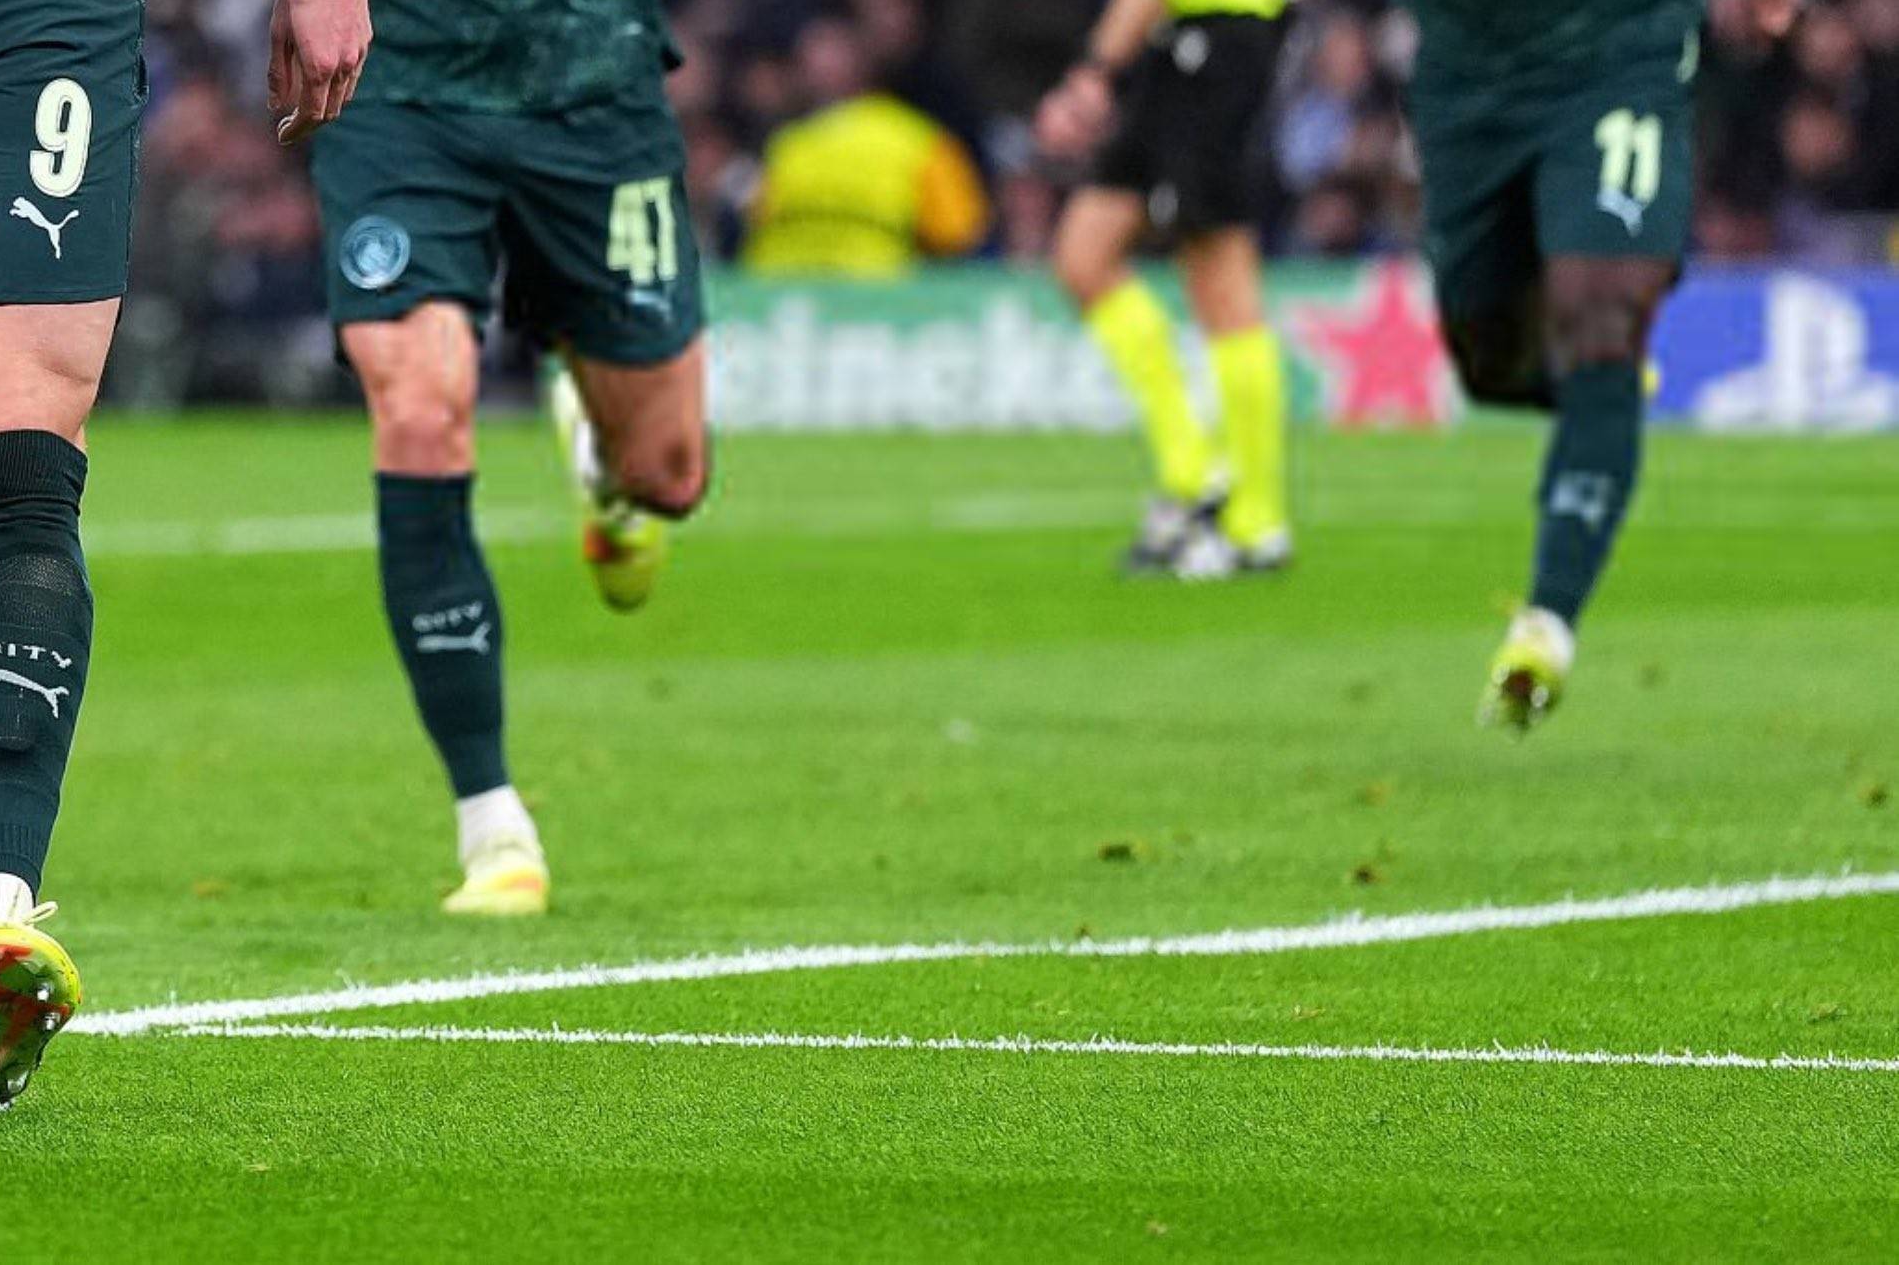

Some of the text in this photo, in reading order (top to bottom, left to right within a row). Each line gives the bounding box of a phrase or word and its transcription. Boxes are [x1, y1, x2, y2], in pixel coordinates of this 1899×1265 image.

[29, 77, 93, 198] 9
[1594, 108, 1663, 203] 11
[606, 176, 677, 287] 41
